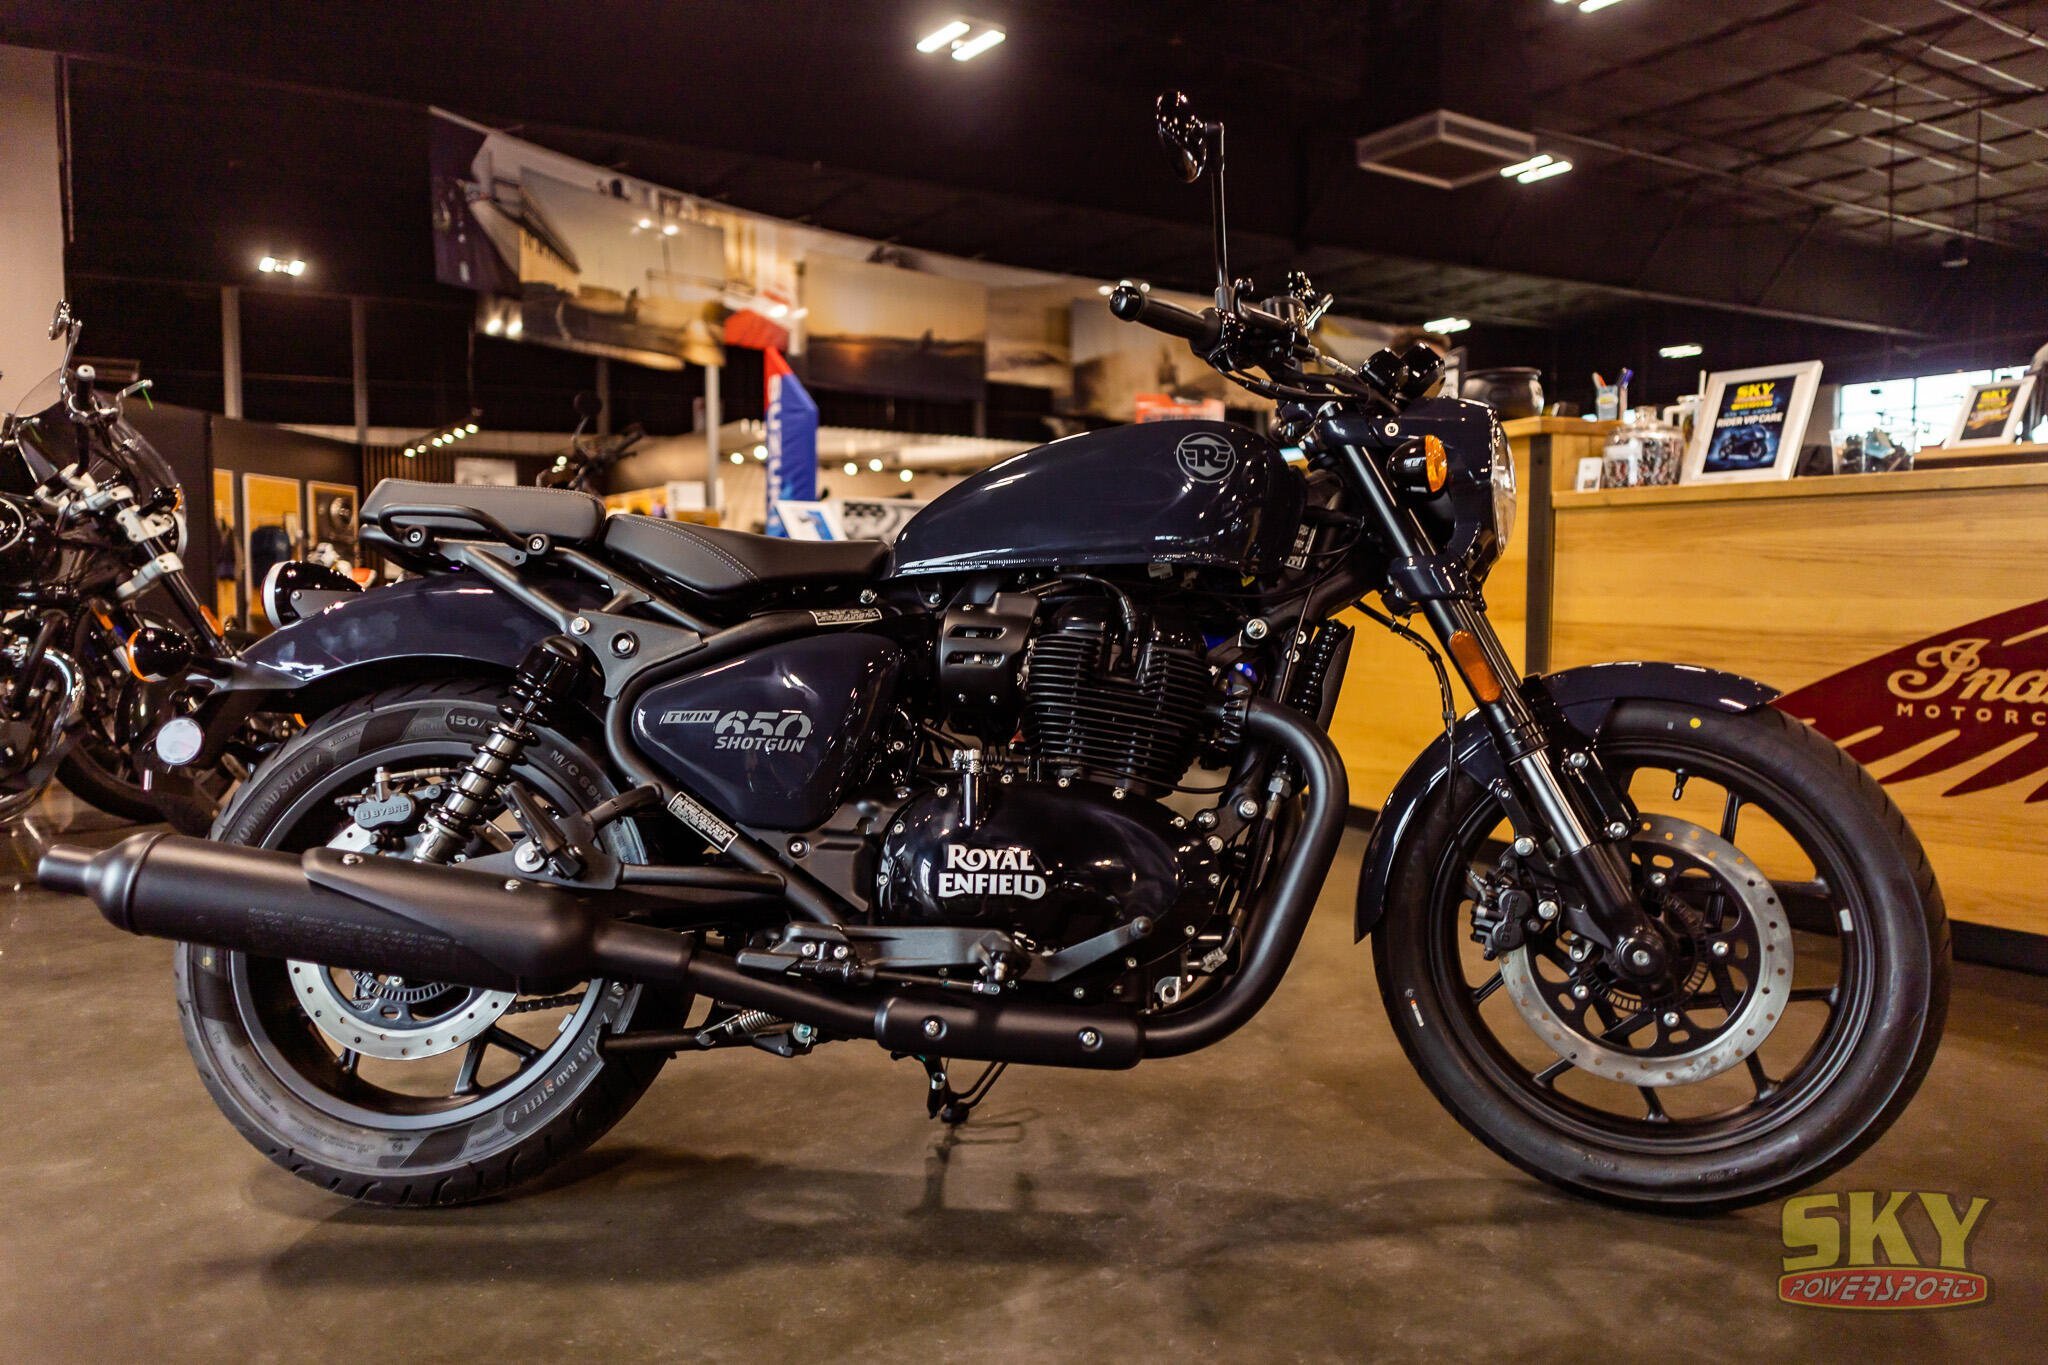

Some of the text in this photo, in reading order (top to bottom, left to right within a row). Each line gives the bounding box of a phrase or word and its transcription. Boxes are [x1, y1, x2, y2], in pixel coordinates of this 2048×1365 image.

[1737, 382, 1775, 397] SKY
[669, 710, 812, 738] TWIN 650
[1896, 702, 2047, 726] MOTORC
[714, 736, 806, 753] SHOTGUN
[550, 749, 580, 777] M/C
[946, 844, 1035, 872] ROYAL
[938, 872, 1047, 900] ENFIELD
